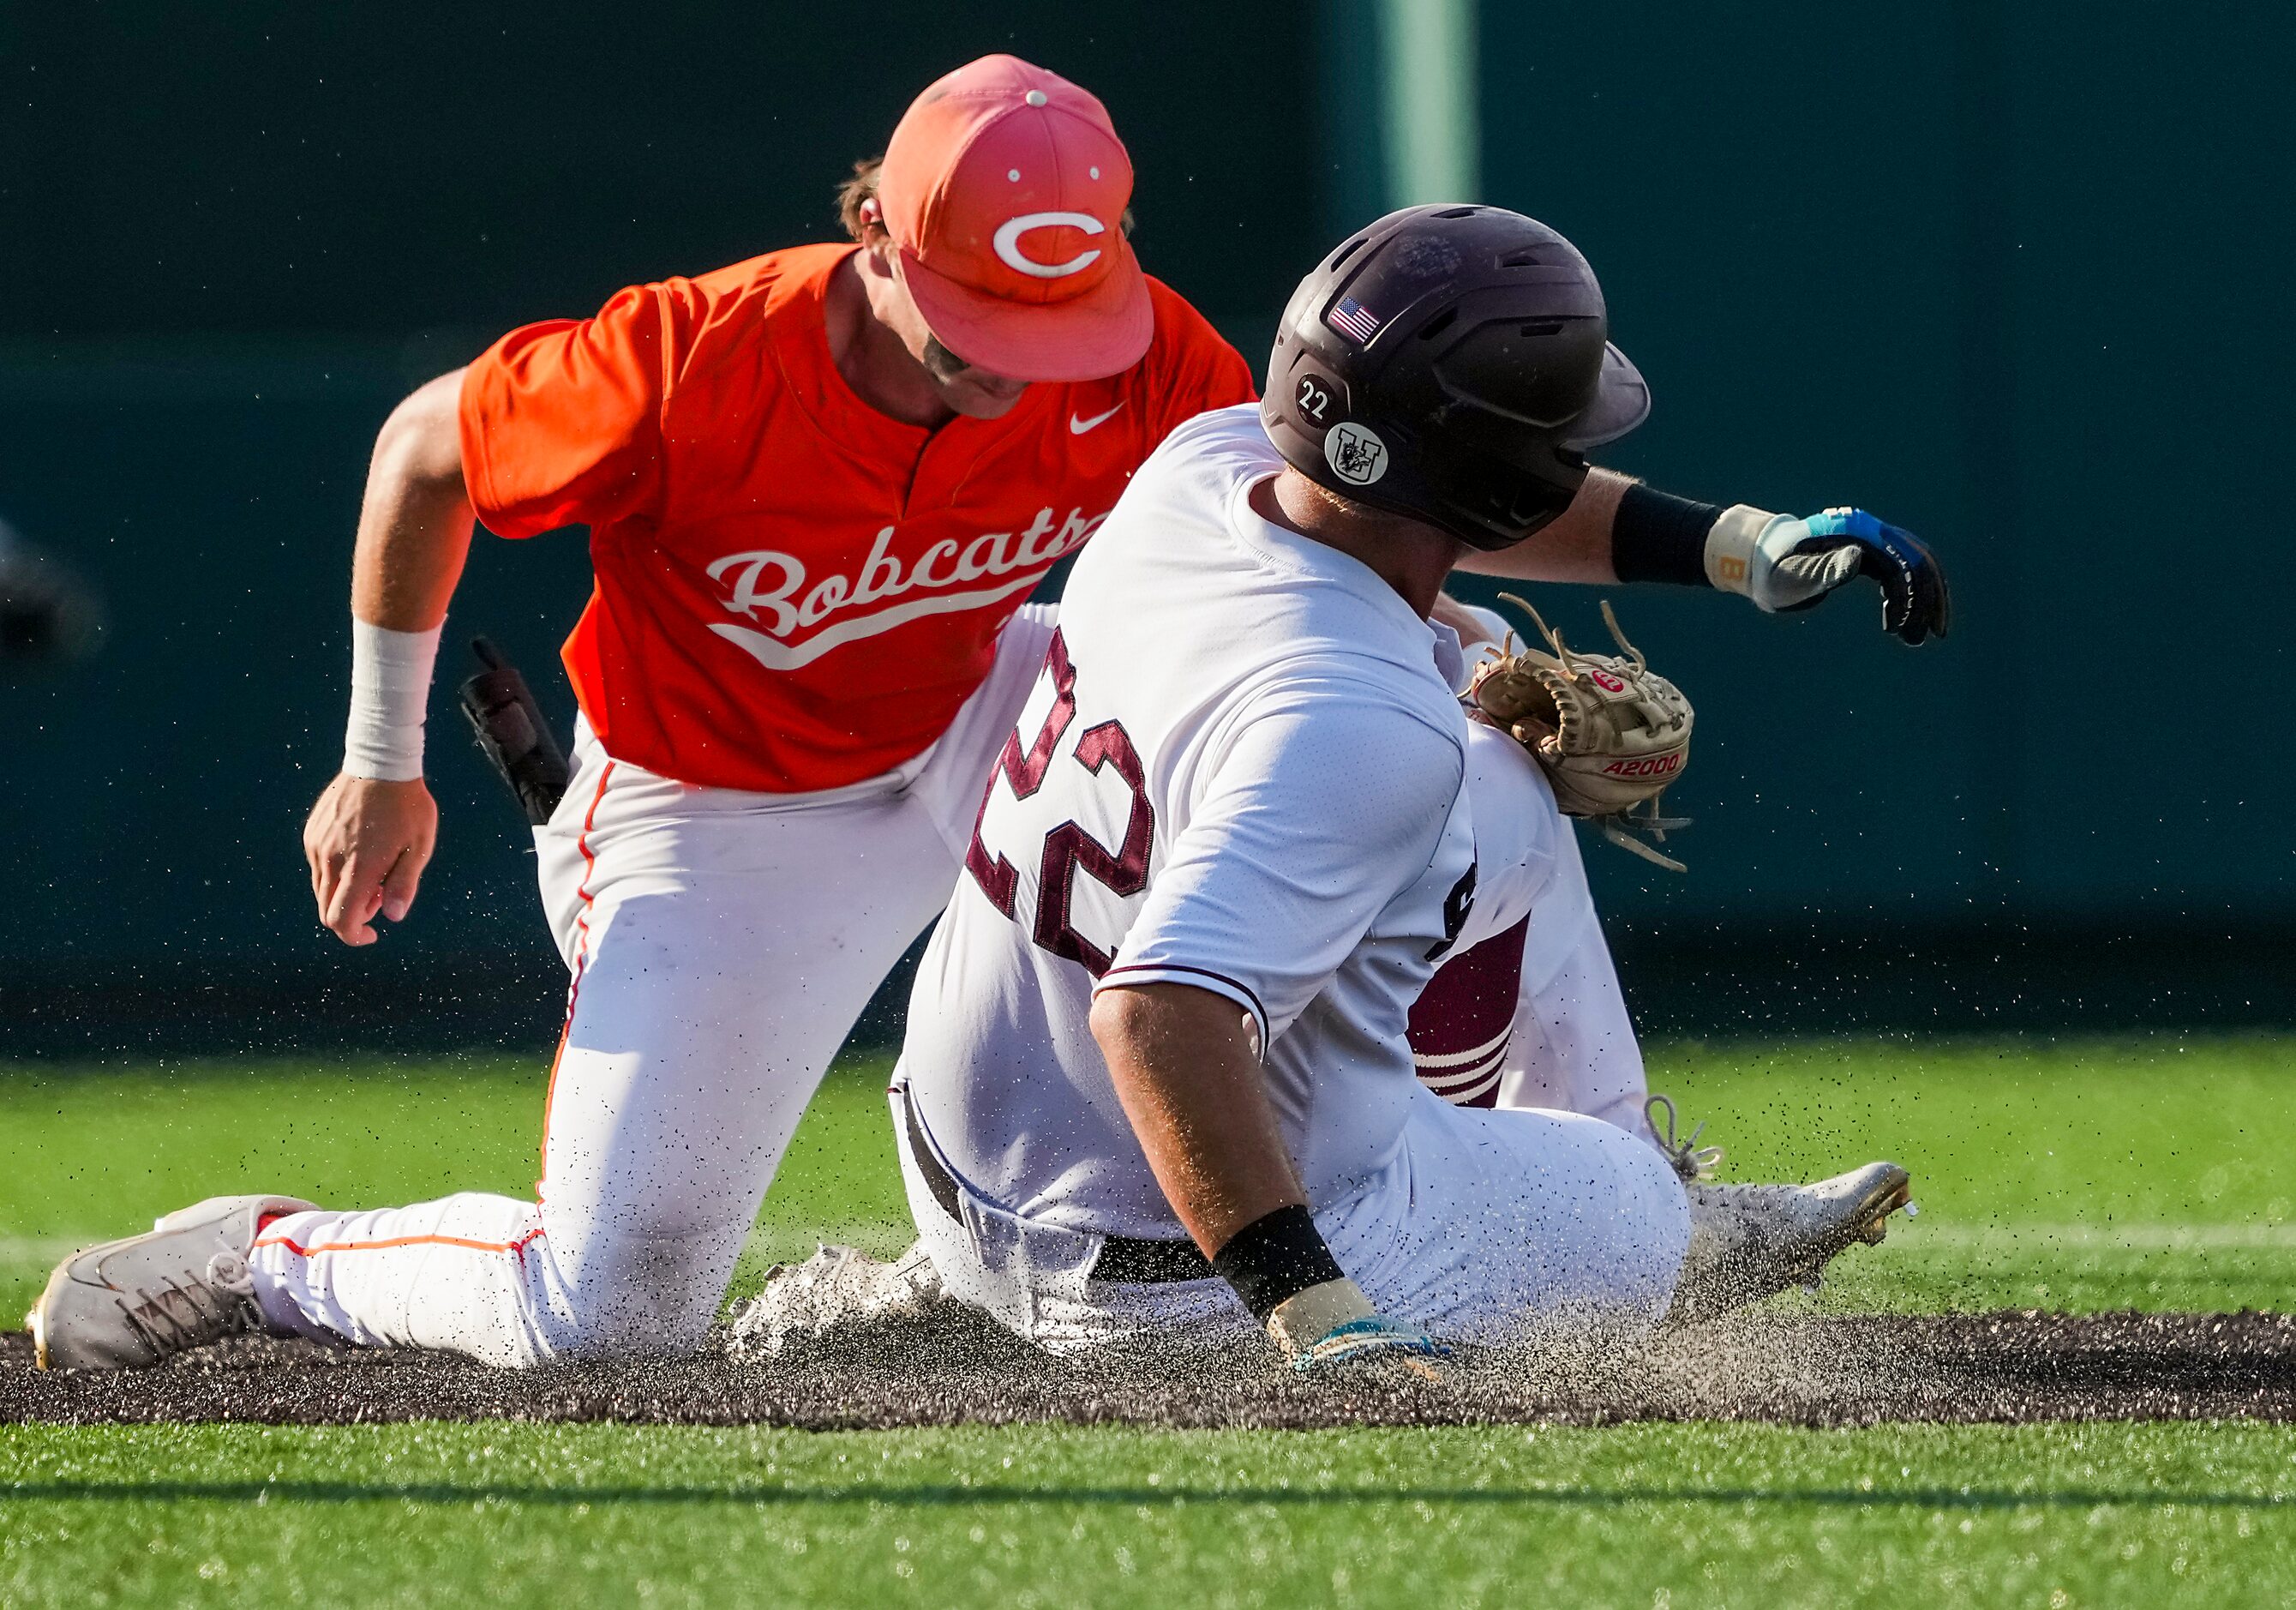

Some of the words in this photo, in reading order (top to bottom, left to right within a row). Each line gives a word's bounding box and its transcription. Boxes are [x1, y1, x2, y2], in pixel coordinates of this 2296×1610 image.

[992, 211, 1106, 279] C
[1298, 380, 1328, 420] 22
[706, 508, 1113, 637] Bobcats
[1604, 753, 1681, 776] A2000
[966, 623, 1155, 980] 22
